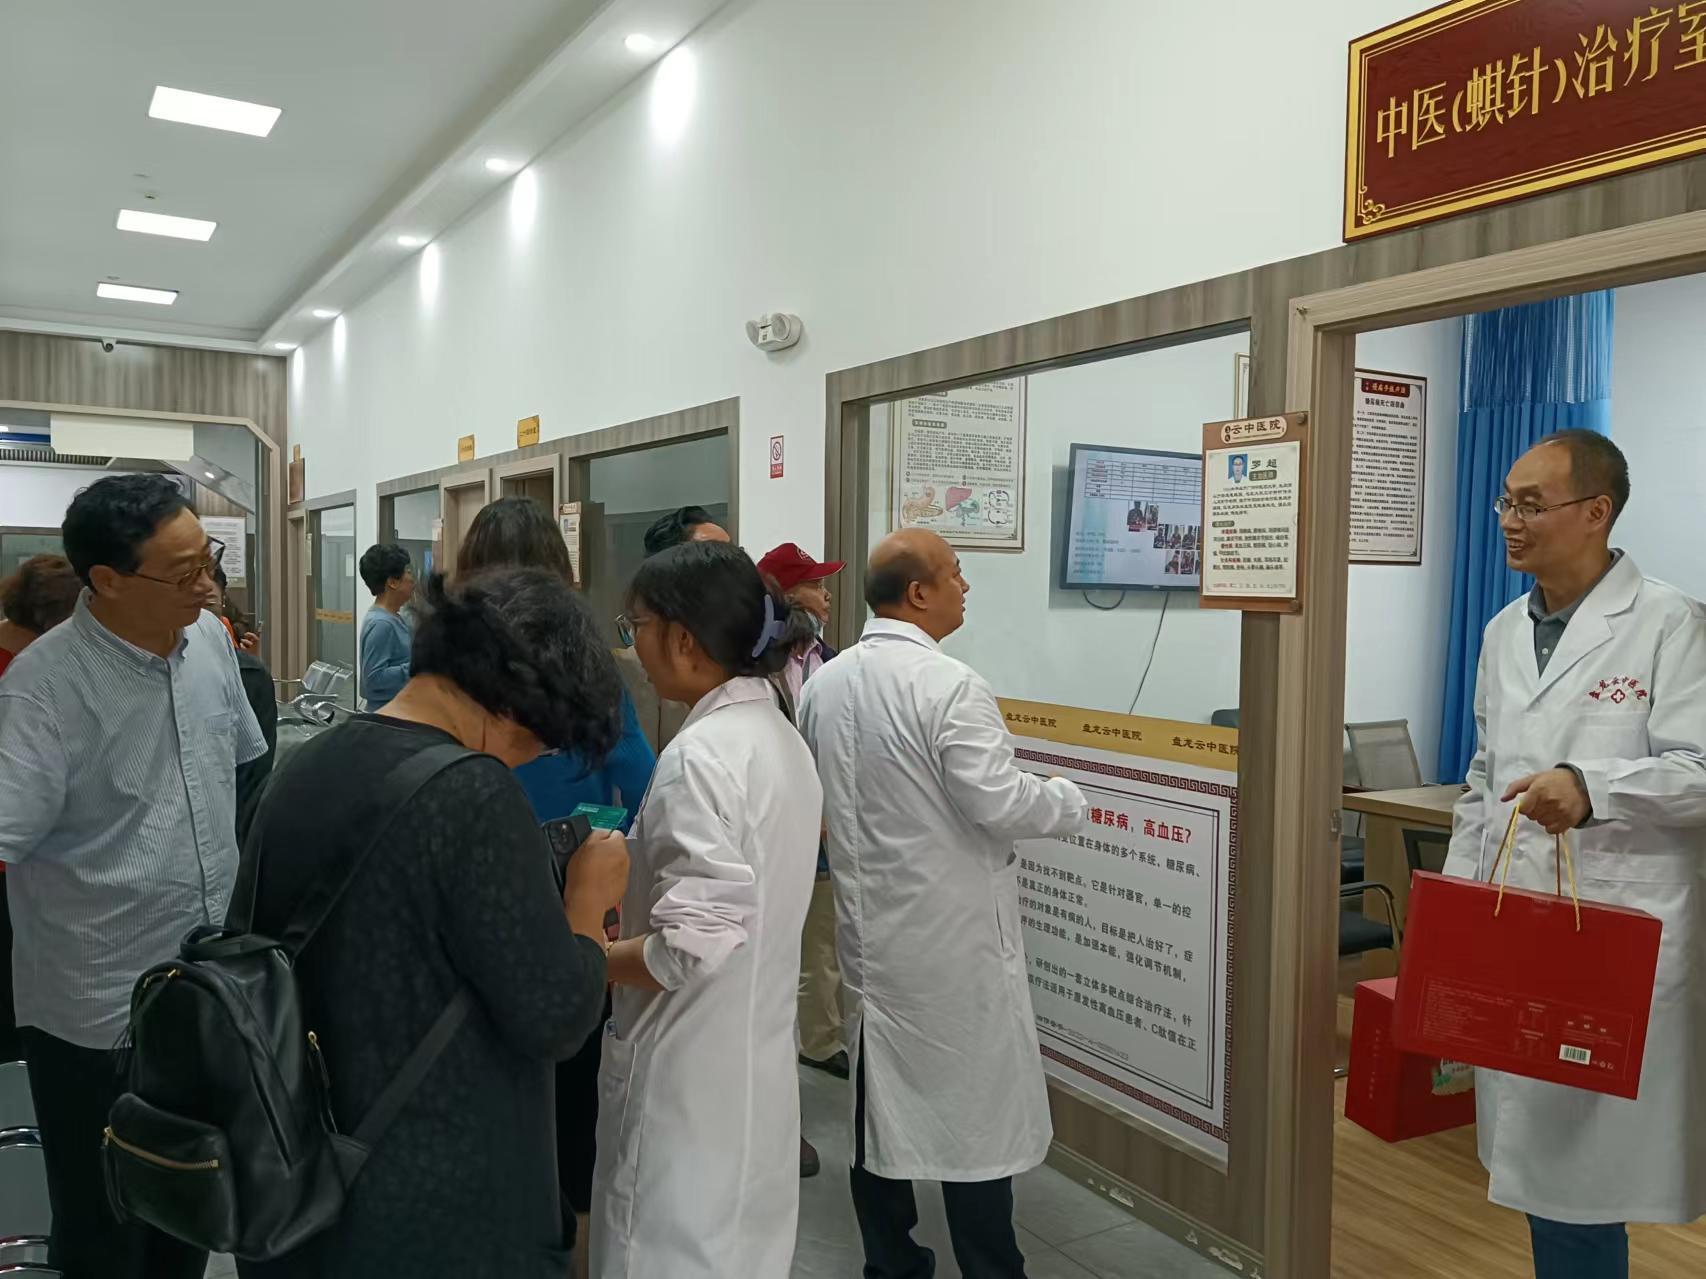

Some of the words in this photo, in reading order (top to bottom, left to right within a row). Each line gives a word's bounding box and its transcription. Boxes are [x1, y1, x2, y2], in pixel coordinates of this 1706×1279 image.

[1082, 723, 1142, 741] 盘龙云中医院
